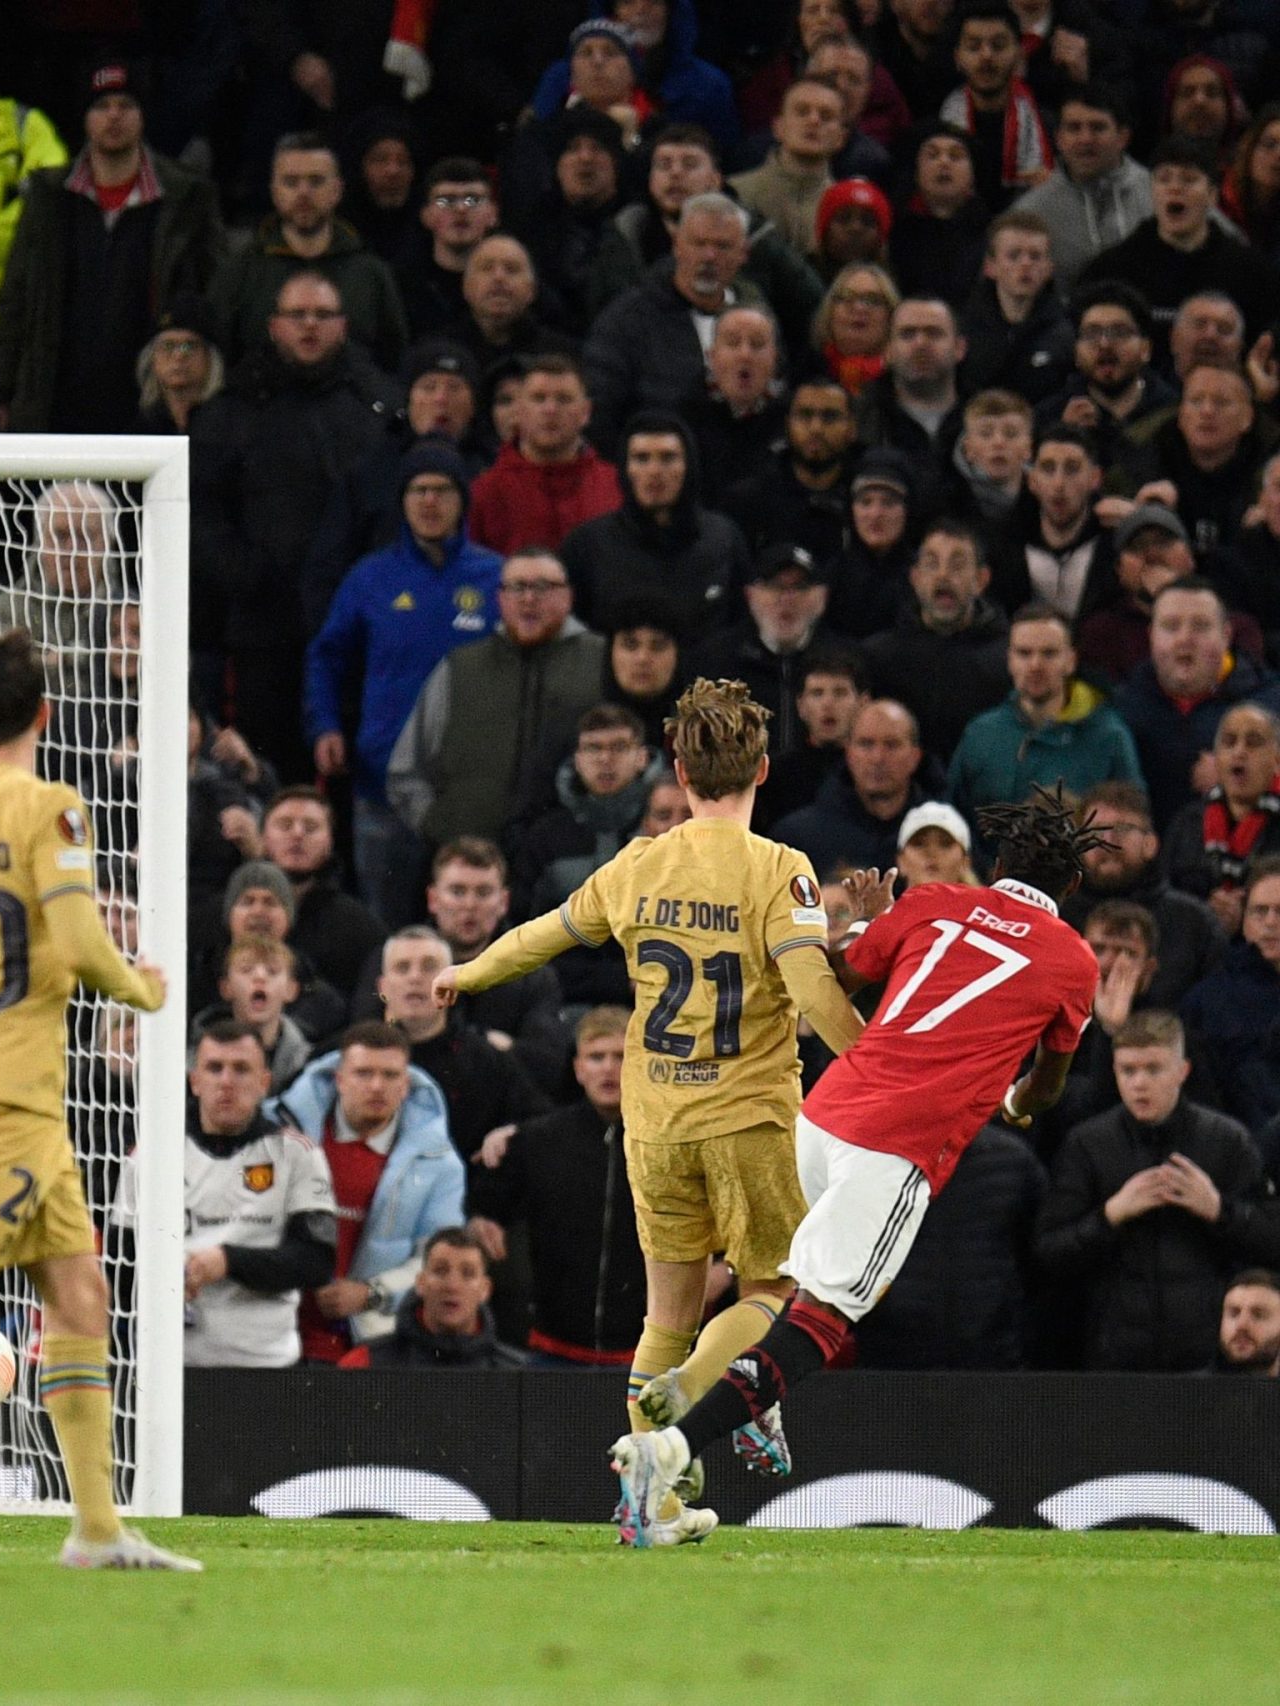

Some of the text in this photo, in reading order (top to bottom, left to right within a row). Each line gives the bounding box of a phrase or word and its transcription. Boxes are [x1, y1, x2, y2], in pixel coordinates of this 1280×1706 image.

[635, 896, 739, 933] F. DE JONG
[966, 905, 1032, 938] FRED
[880, 919, 1032, 1034] 17
[637, 939, 743, 1058] 21
[673, 1071, 719, 1082] ACNUR
